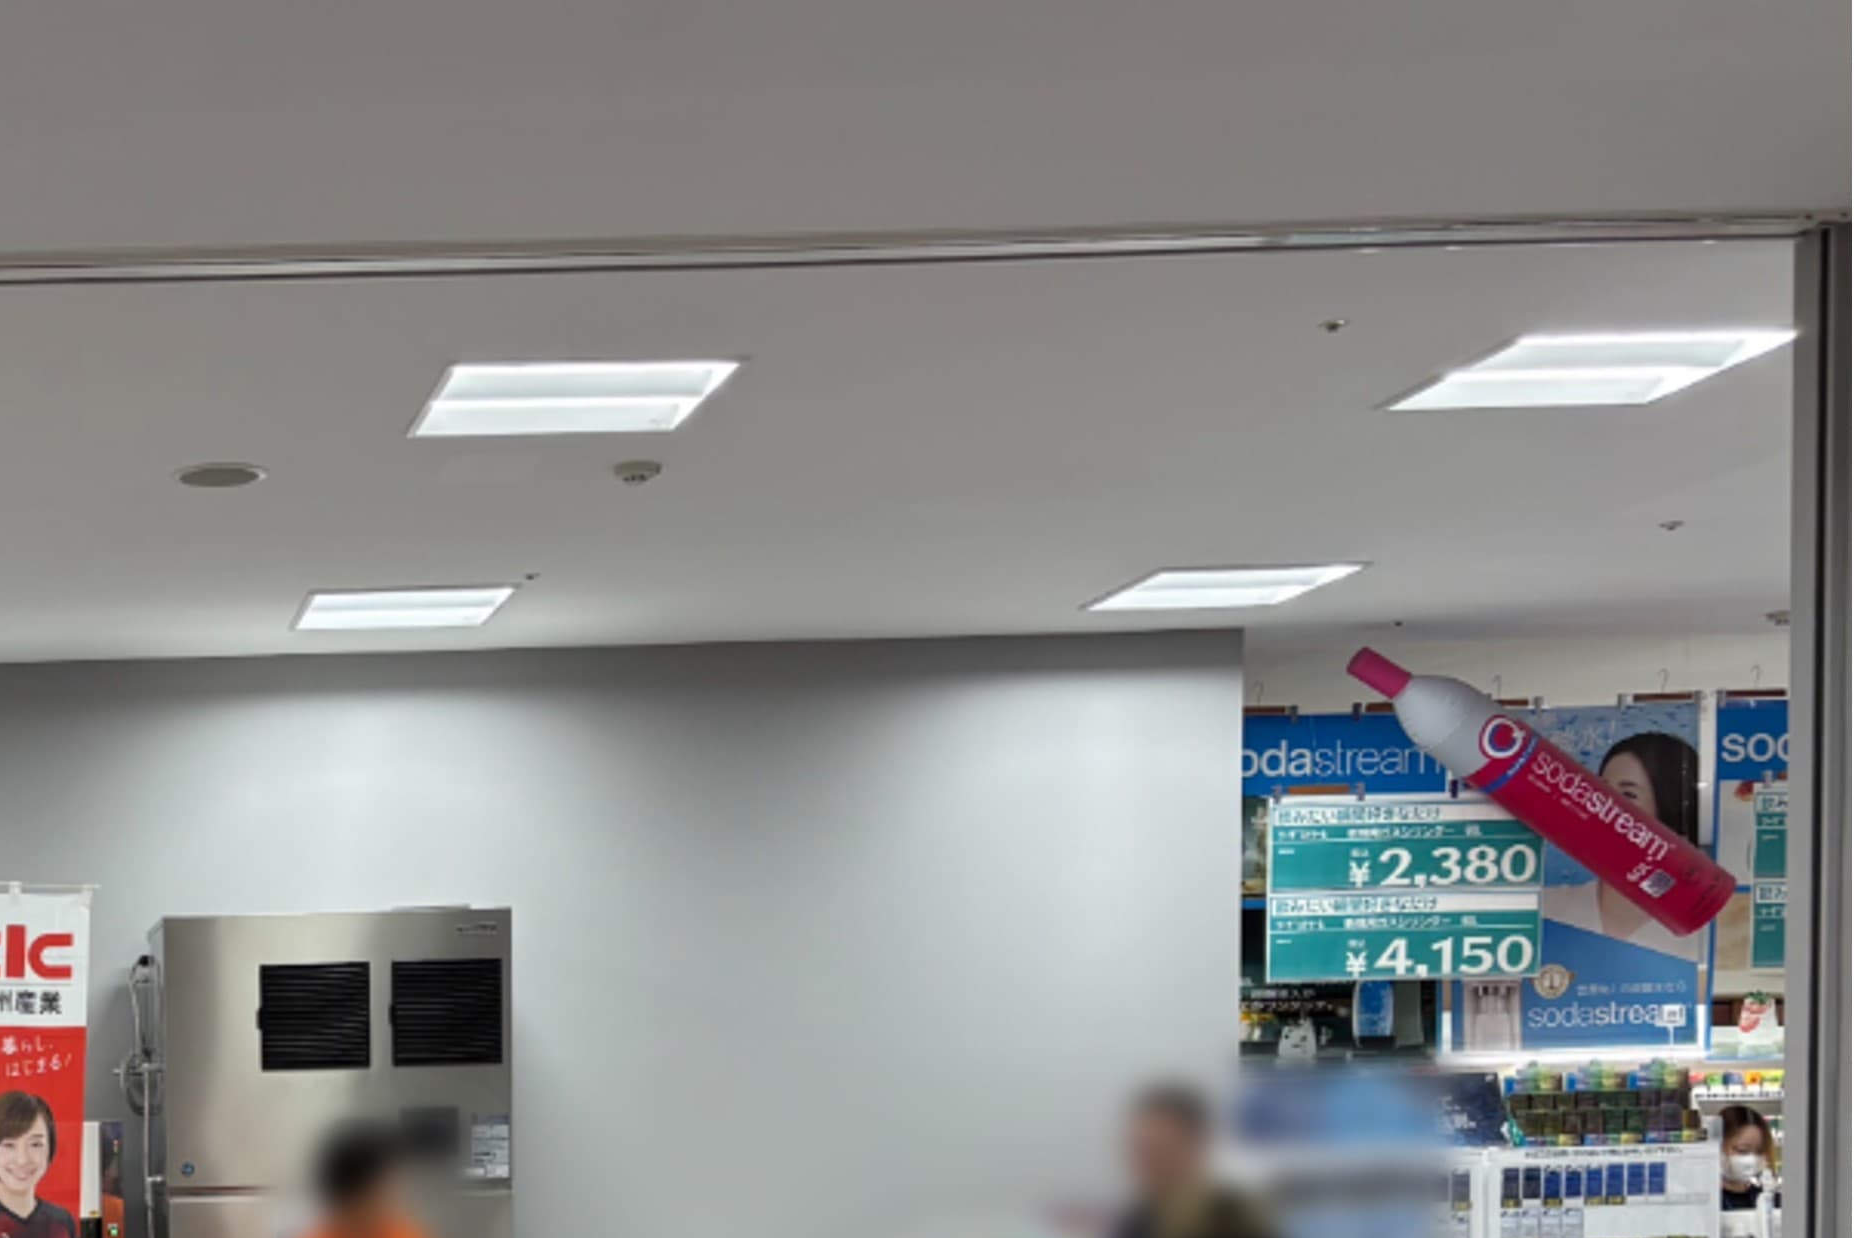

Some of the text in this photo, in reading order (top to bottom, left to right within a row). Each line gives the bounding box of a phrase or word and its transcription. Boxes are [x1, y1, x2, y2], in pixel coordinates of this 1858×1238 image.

[1242, 739, 1441, 777] odastream
[1531, 753, 1672, 862] sodastream
[1348, 843, 1538, 889] ¥2,380
[1345, 934, 1534, 978] ¥4,150
